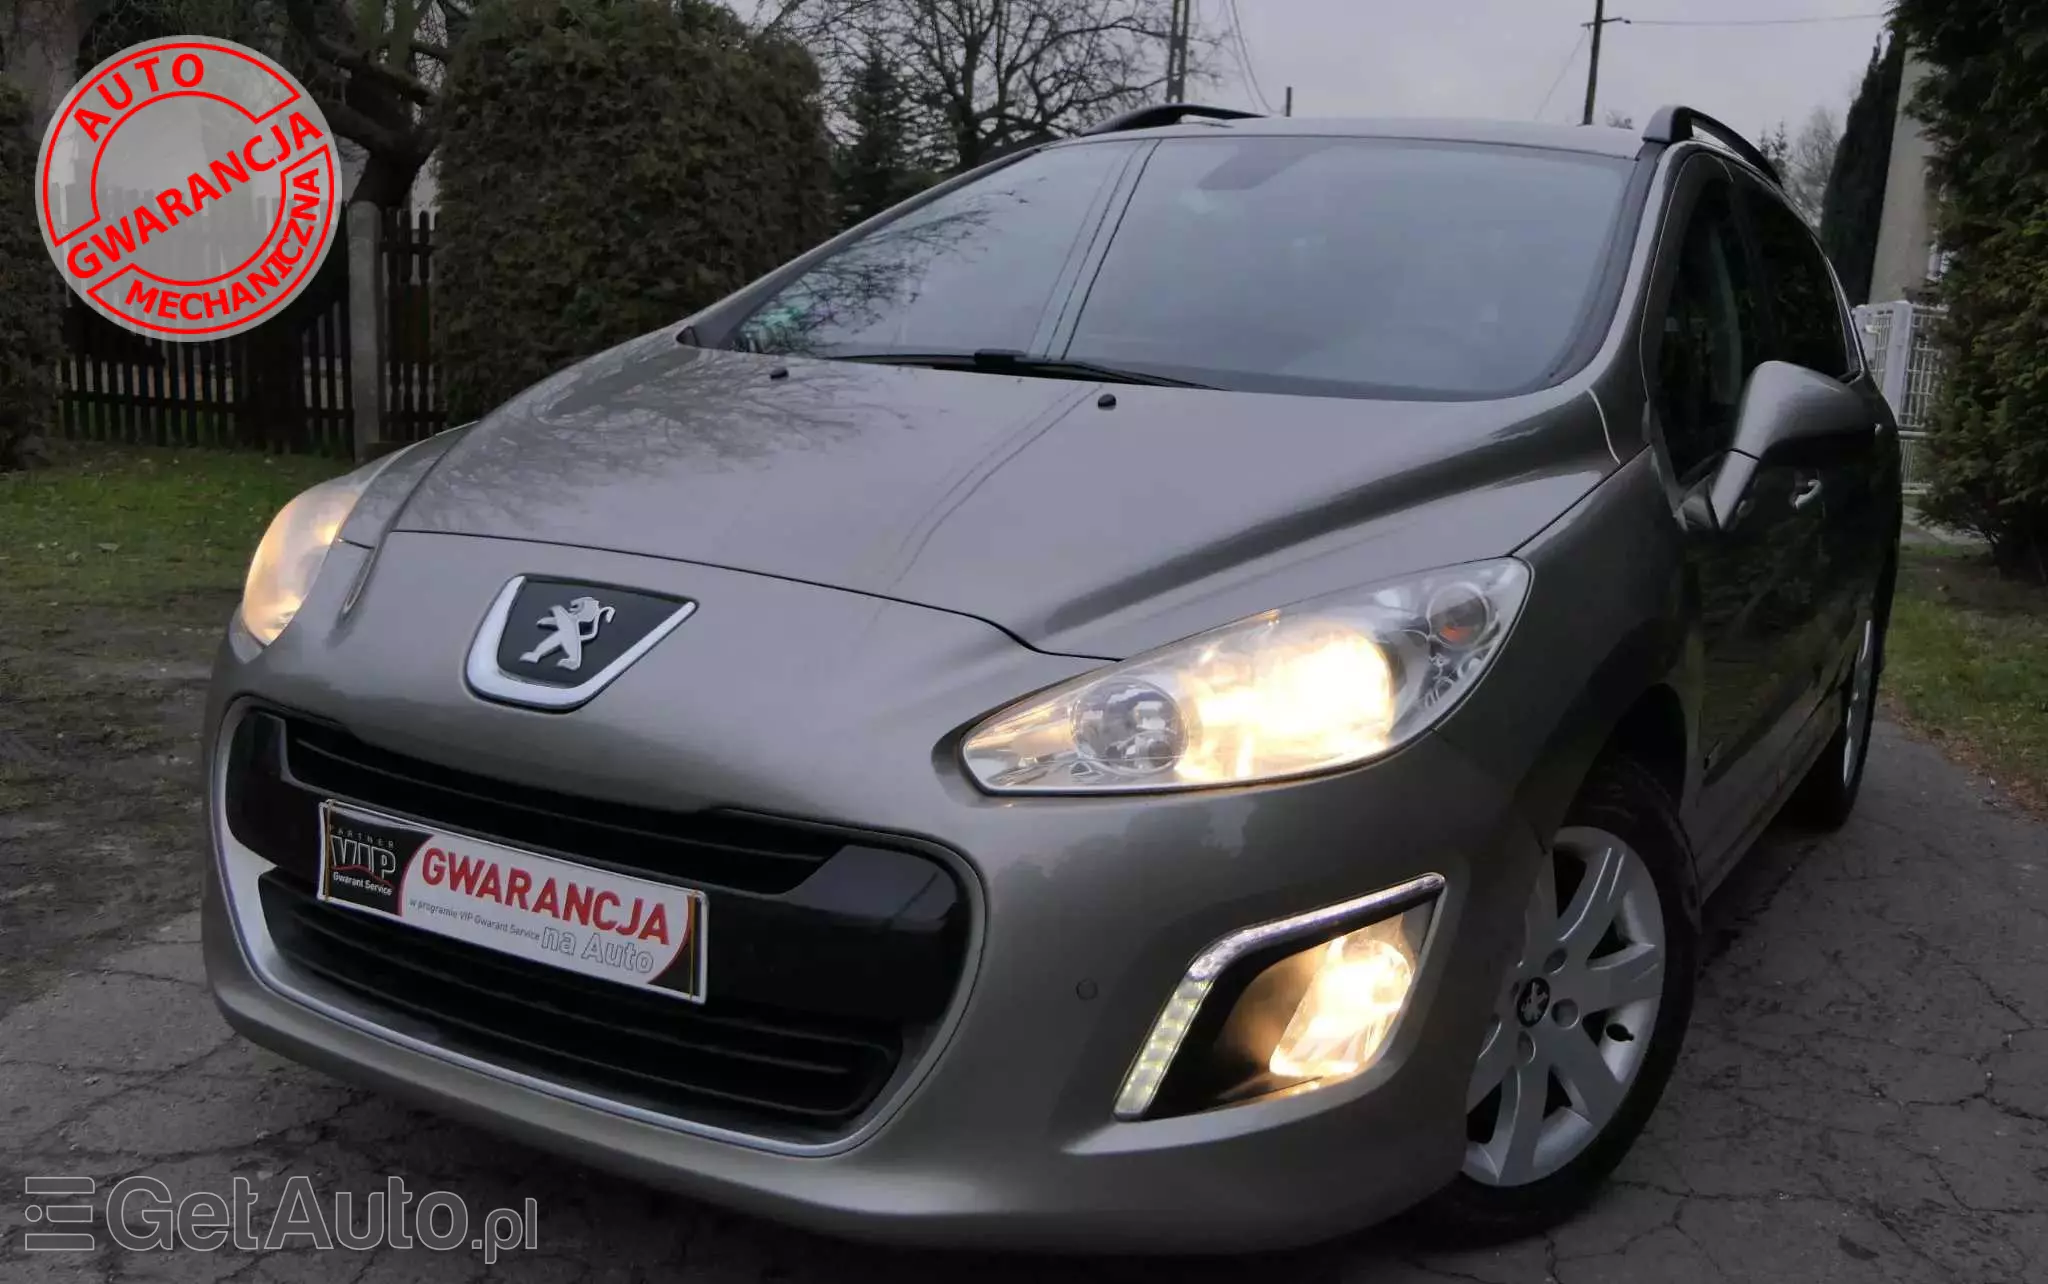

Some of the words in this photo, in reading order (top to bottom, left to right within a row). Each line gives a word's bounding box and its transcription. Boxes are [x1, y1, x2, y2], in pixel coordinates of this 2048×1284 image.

[329, 834, 397, 880] VIP
[332, 871, 364, 889] Gwarant
[364, 879, 394, 896] Service
[421, 847, 670, 946] GWARANCJA
[408, 897, 416, 907] w
[417, 900, 458, 919] programie
[459, 911, 475, 922] VIP
[474, 914, 509, 933] Gwarant
[509, 924, 541, 941] Service
[541, 926, 577, 956] na
[581, 932, 655, 974] Auto
